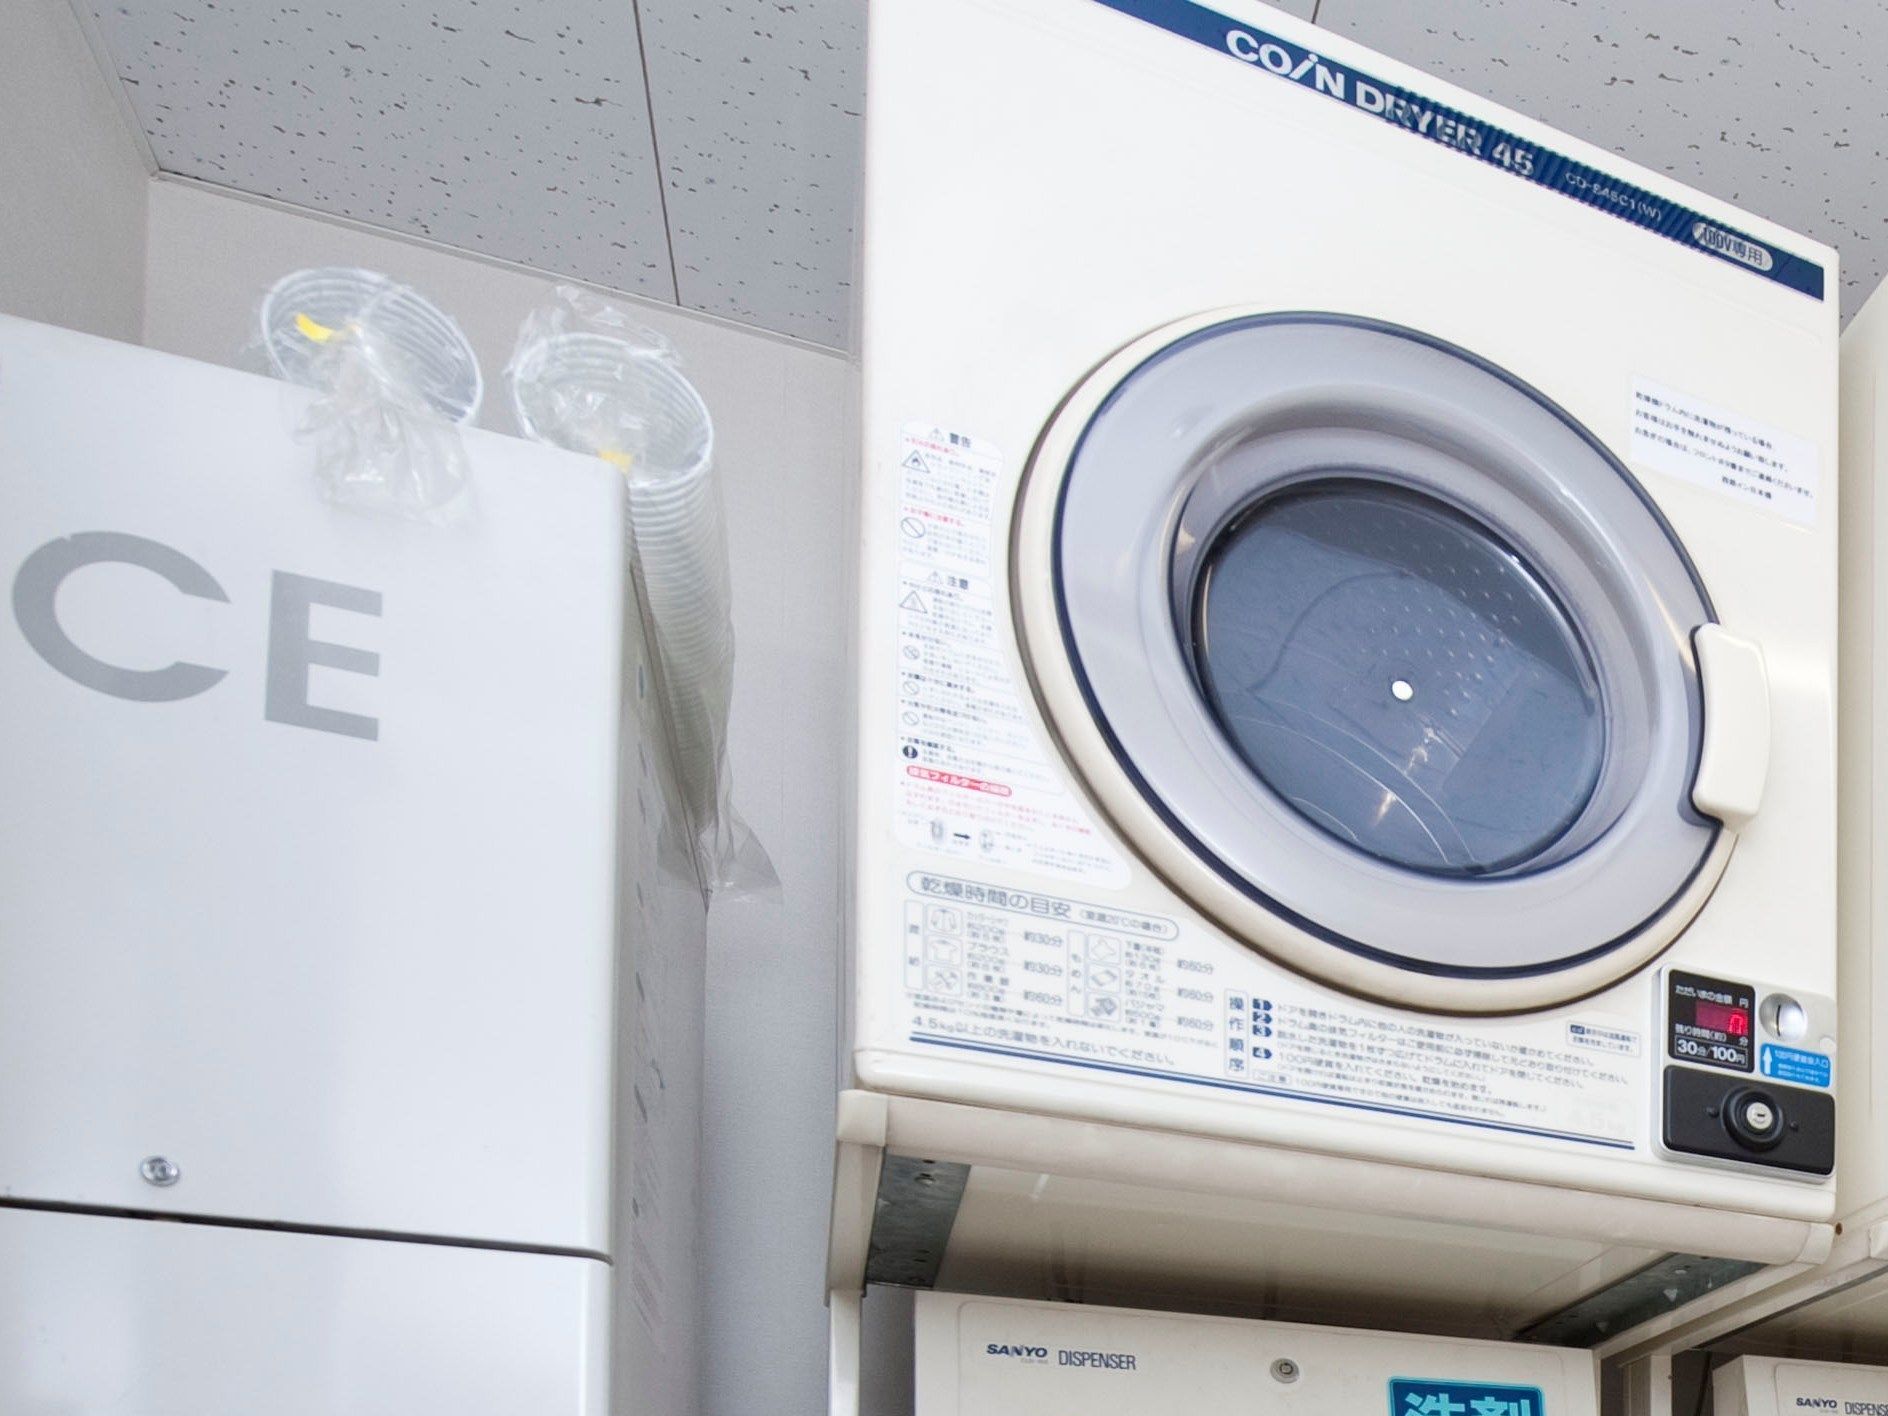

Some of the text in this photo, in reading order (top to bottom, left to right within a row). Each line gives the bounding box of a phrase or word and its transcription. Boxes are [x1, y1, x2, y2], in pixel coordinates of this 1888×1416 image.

[1356, 81, 1482, 157] DRYER
[1491, 142, 1535, 177] 45
[921, 876, 1071, 919] 乾燥時間の目安
[986, 1343, 1048, 1360] SANYO
[1058, 1349, 1137, 1372] DISPENSER
[1796, 1396, 1838, 1409] SANYO
